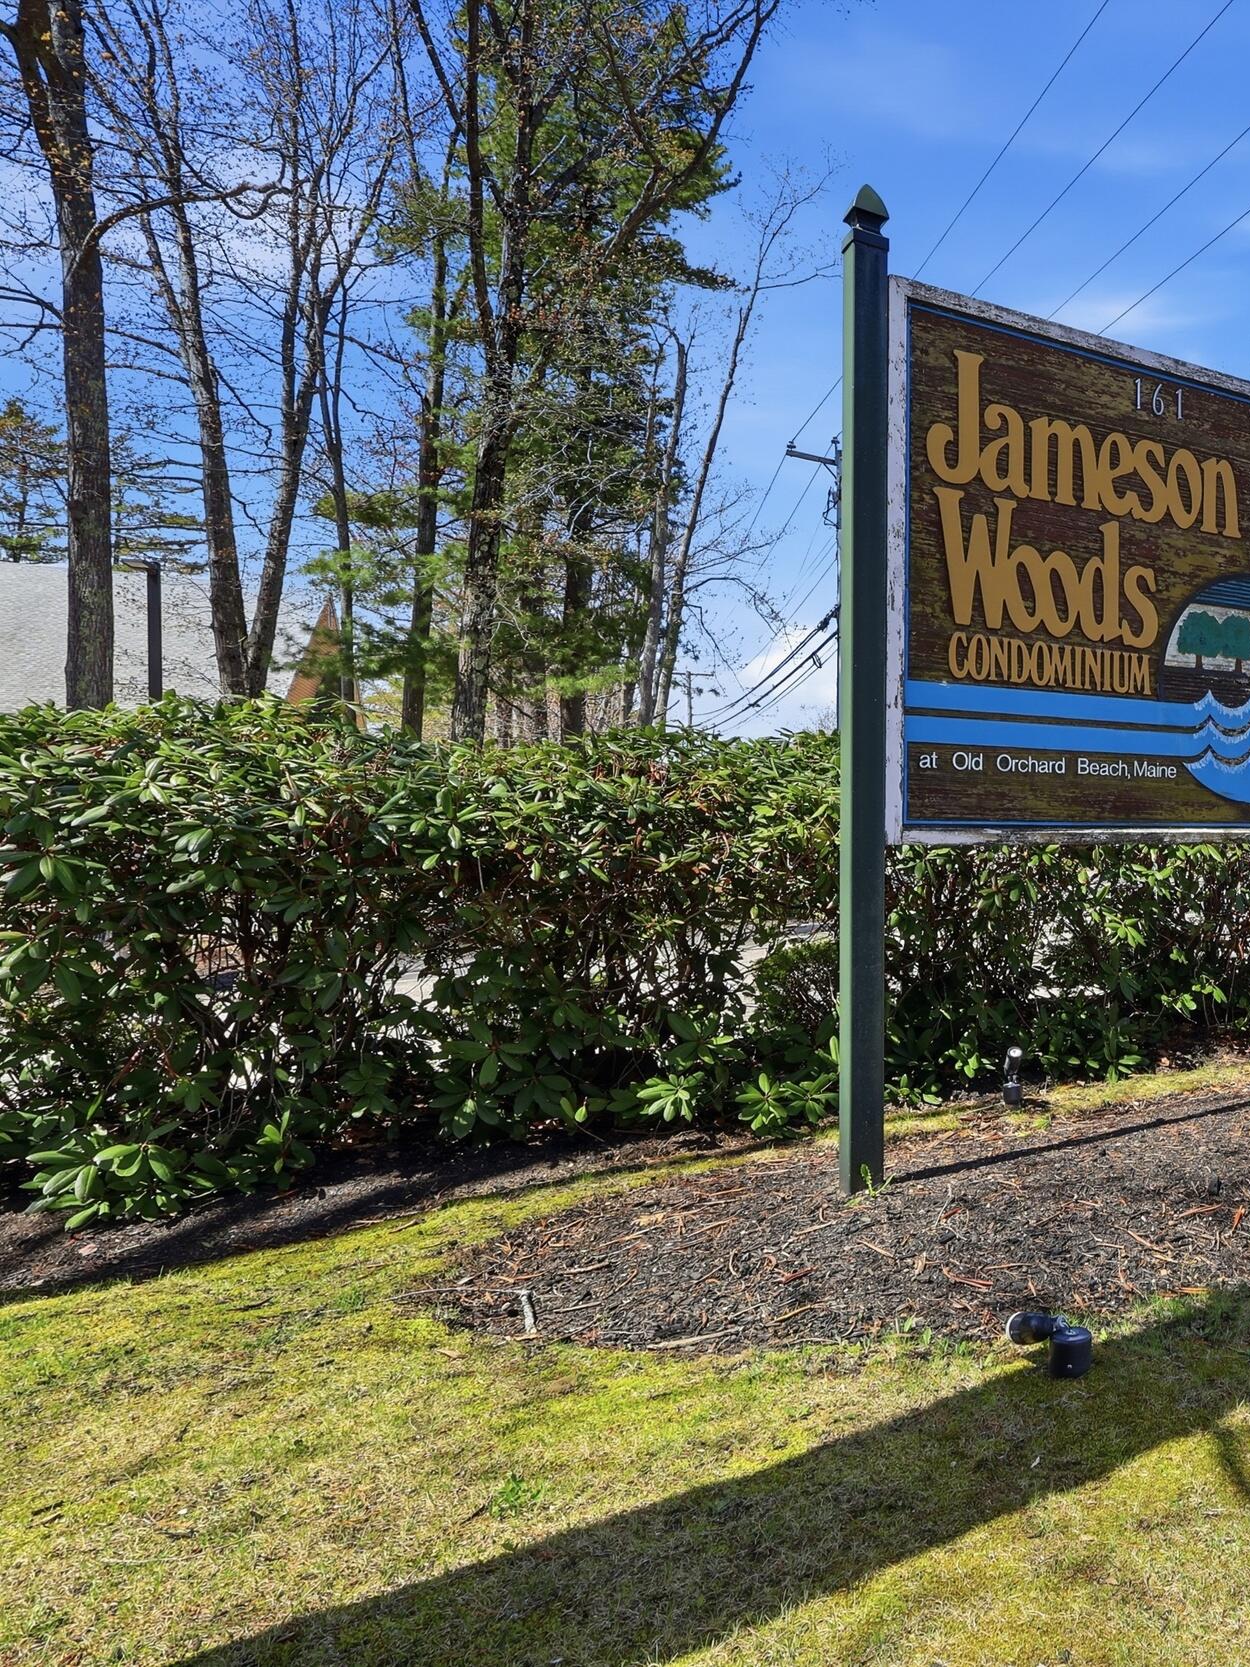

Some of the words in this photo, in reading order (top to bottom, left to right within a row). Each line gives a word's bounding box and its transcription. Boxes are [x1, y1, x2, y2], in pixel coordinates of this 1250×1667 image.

[1134, 377, 1187, 420] 161
[926, 349, 1241, 538] Jameson
[932, 486, 1159, 648] Woods
[947, 631, 1152, 695] CONDOMINIUM
[918, 752, 938, 769] at
[952, 751, 983, 772] Old
[996, 753, 1066, 775] Orchard
[1133, 760, 1177, 778] Maine
